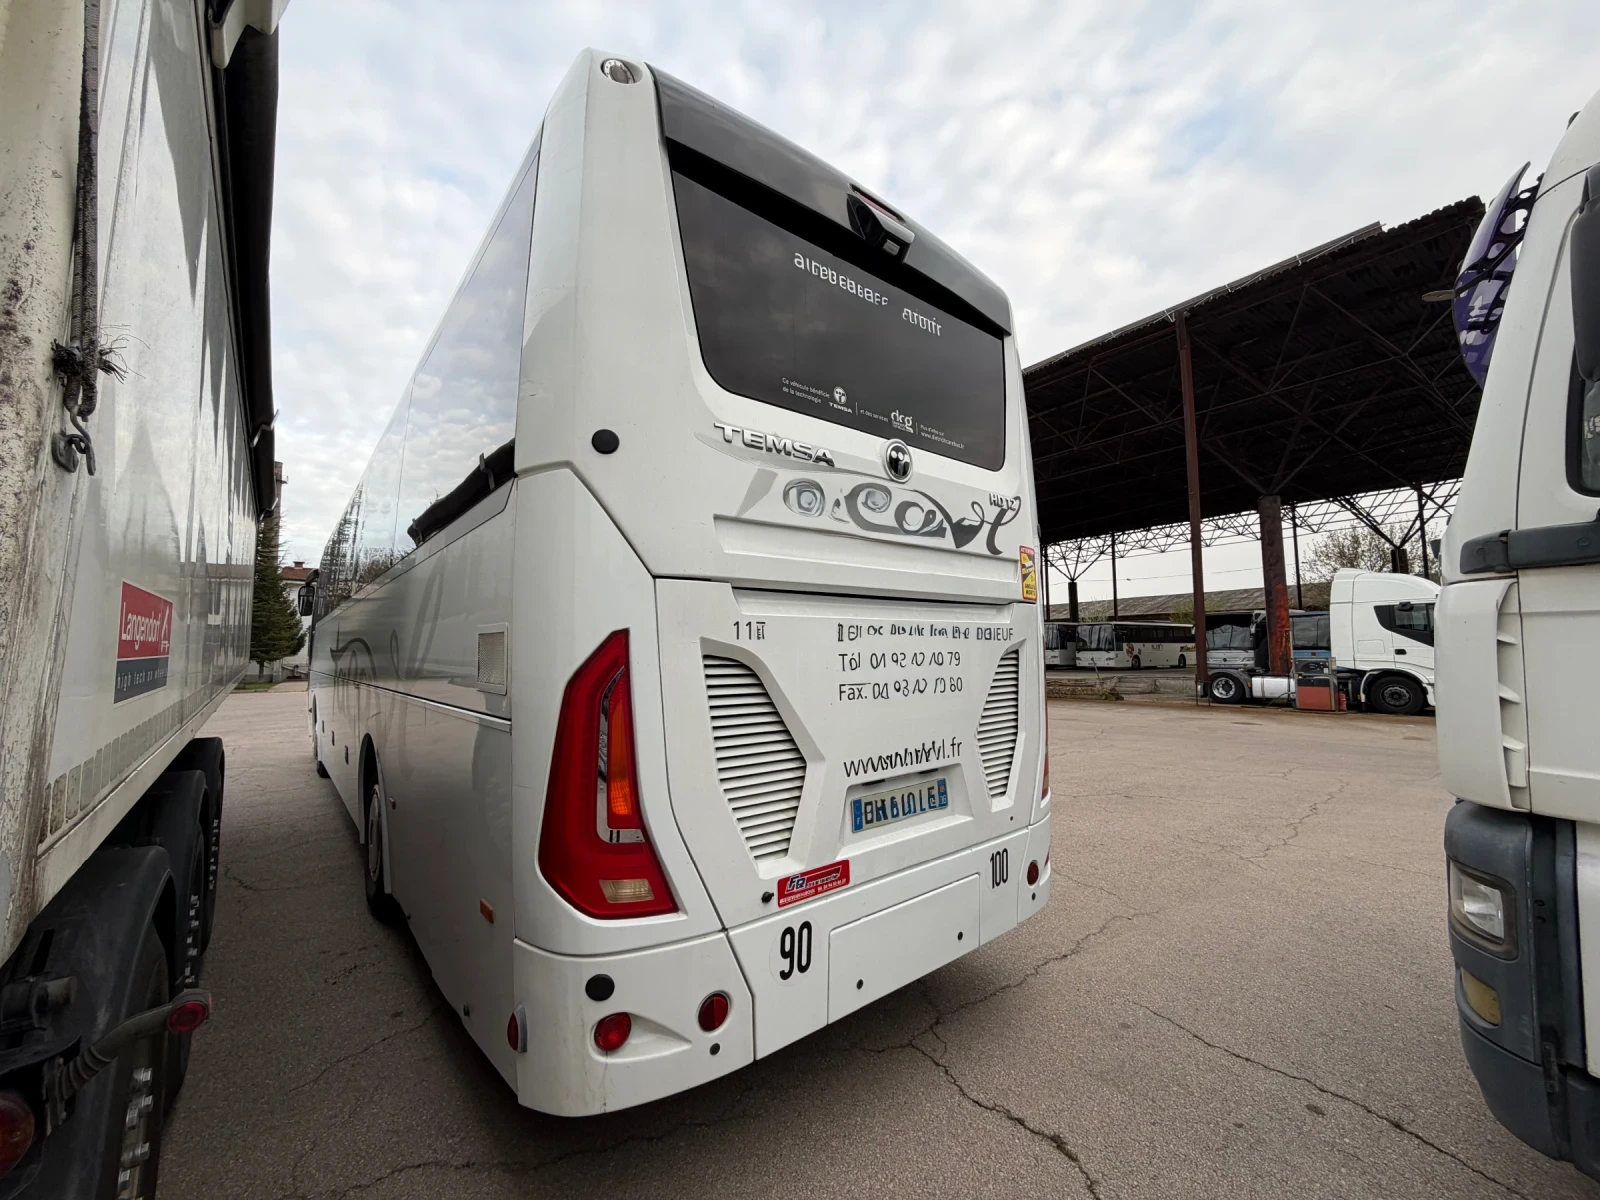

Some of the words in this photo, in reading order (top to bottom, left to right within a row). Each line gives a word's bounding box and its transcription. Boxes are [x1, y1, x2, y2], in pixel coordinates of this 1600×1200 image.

[828, 401, 853, 414] TEMSA
[713, 422, 835, 467] TEMSA
[121, 602, 161, 651] Langendorf
[990, 848, 1009, 889] 100
[779, 920, 813, 981] 90
